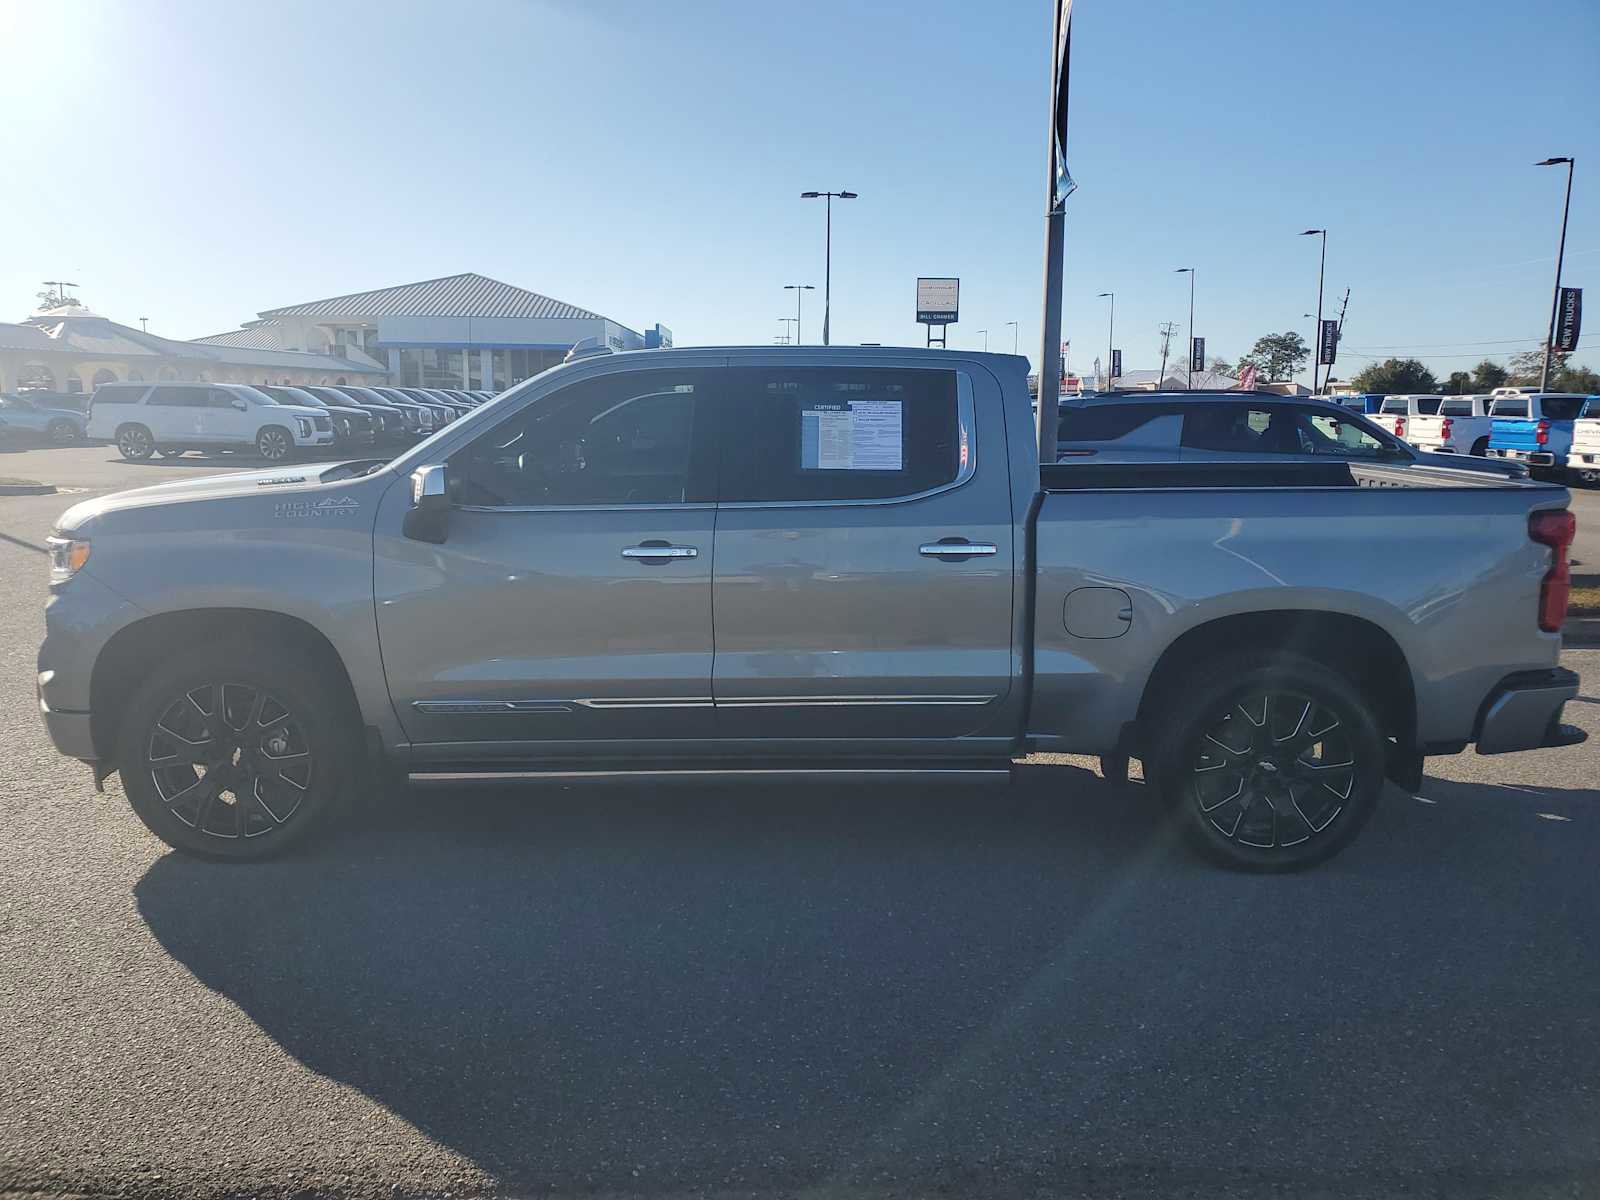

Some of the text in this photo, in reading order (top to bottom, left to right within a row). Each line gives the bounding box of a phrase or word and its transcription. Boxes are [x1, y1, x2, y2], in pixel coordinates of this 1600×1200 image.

[1561, 291, 1576, 349] NEW TRUCKS
[1324, 322, 1333, 363] NEW TRUCKS
[274, 502, 317, 510] HIGH
[274, 509, 356, 518] COUNTRY
